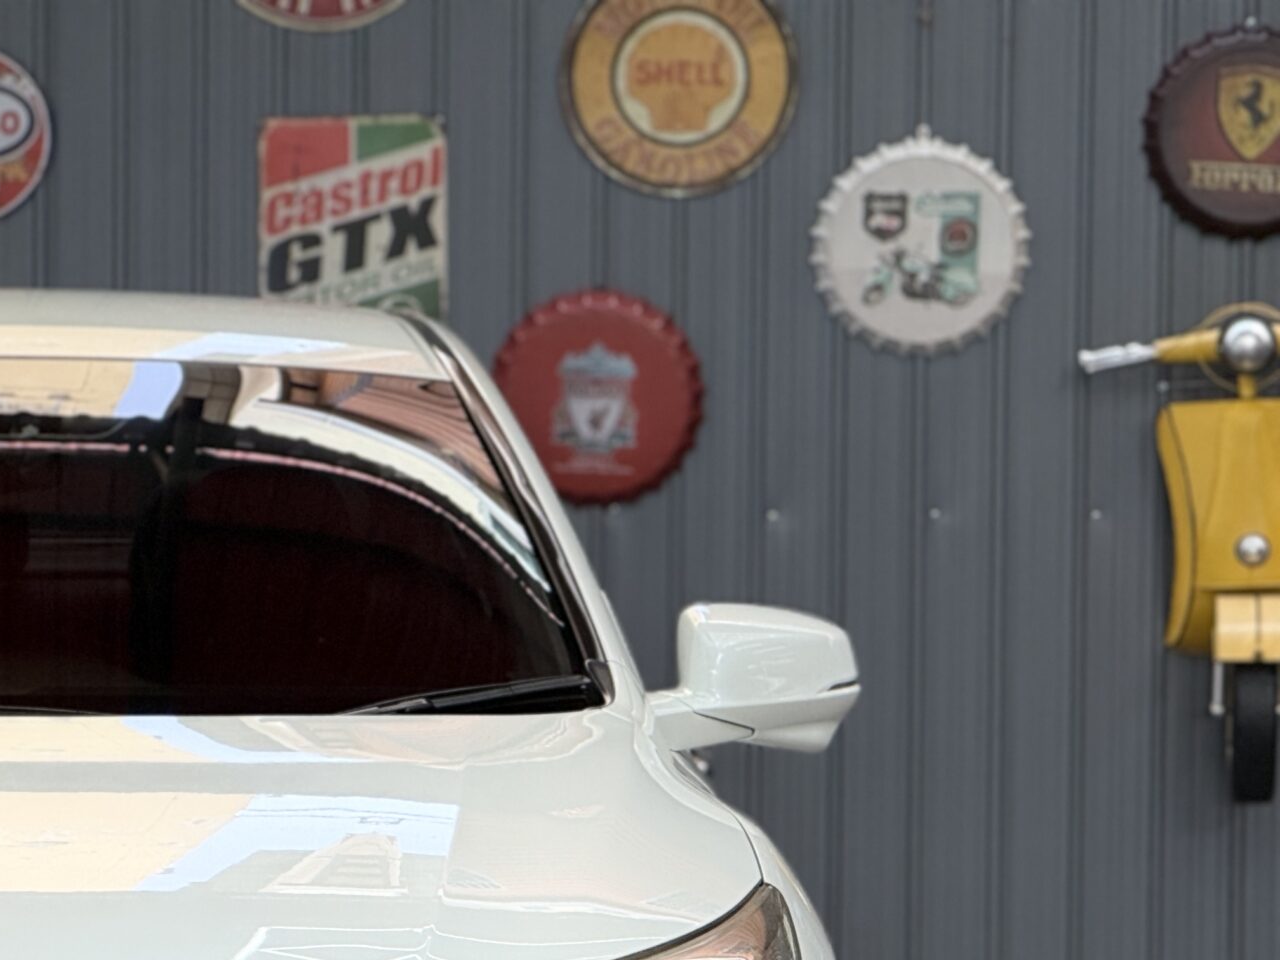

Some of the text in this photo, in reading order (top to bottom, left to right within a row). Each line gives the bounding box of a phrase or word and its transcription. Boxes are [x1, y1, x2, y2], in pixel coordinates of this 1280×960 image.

[635, 58, 726, 87] SHELL
[266, 143, 444, 237] Castrol
[267, 195, 439, 293] GTX
